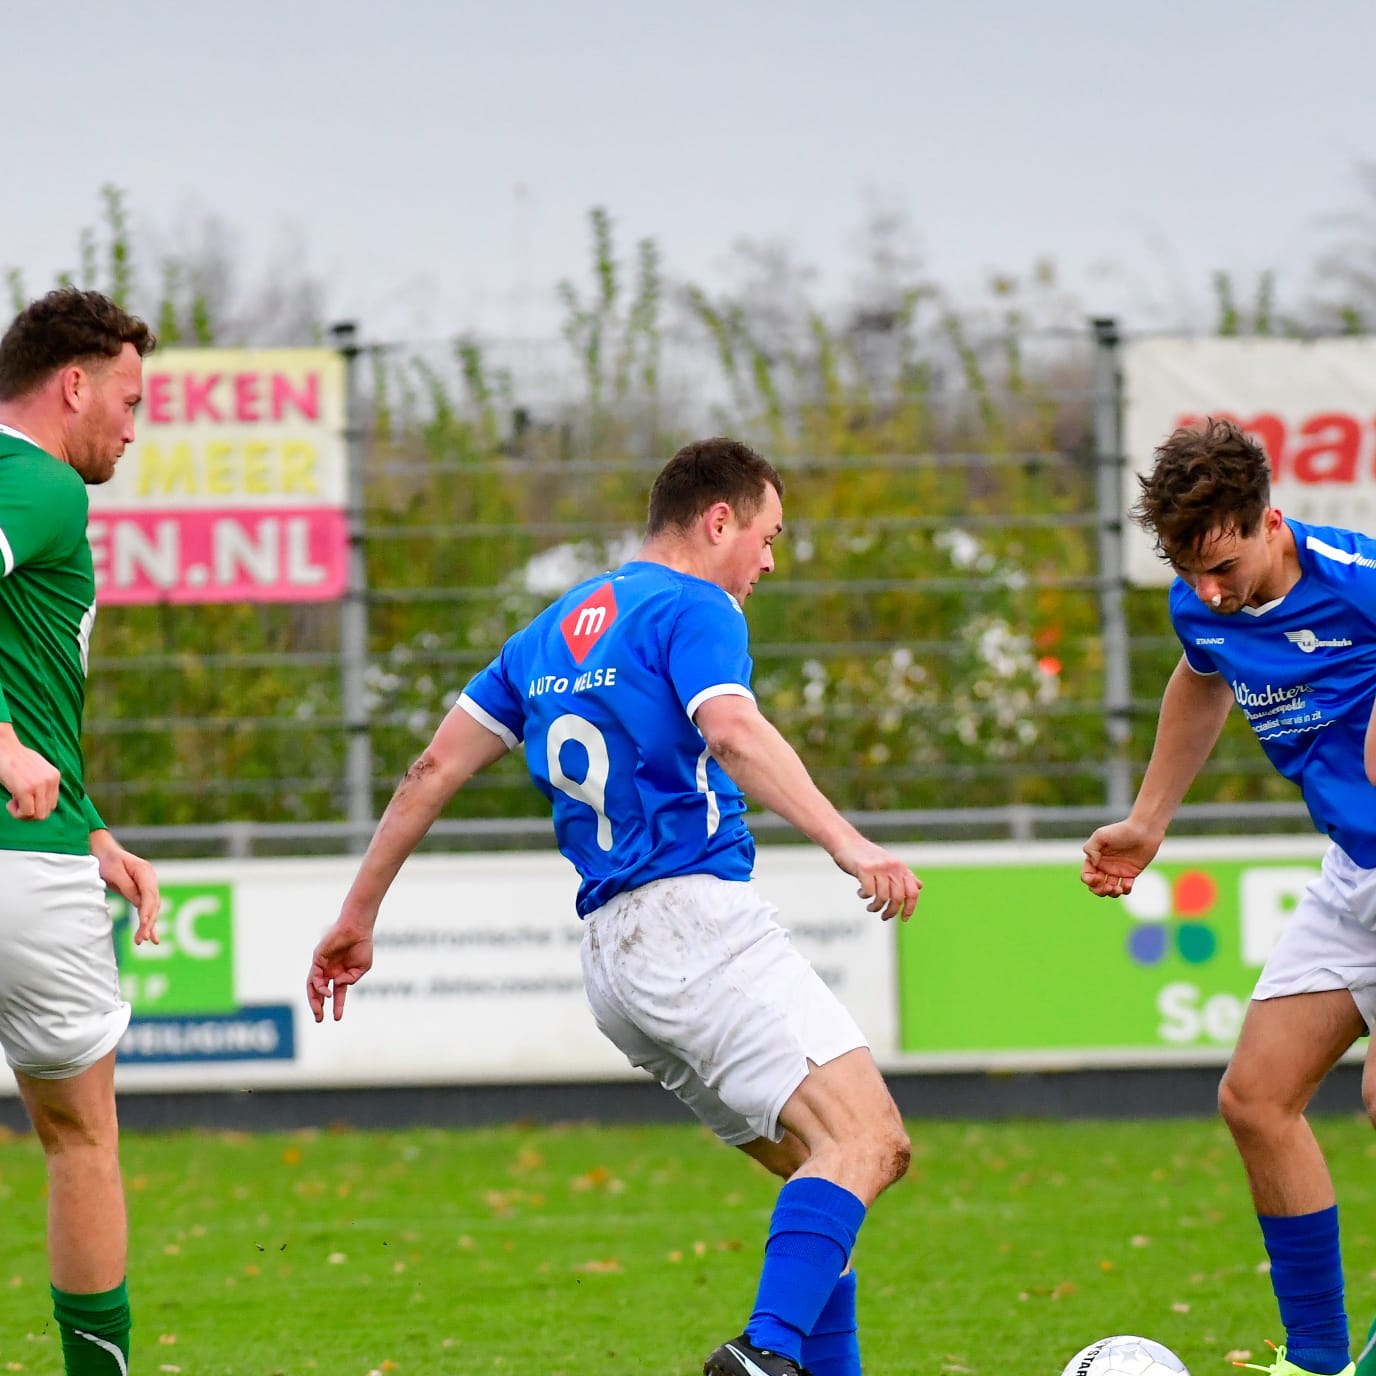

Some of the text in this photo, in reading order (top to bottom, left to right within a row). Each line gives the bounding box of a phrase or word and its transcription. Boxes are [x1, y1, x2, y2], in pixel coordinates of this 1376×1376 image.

[137, 441, 319, 496] MEER
[573, 605, 607, 637] m
[528, 667, 617, 699] AUTO MELSE
[547, 713, 613, 852] 9
